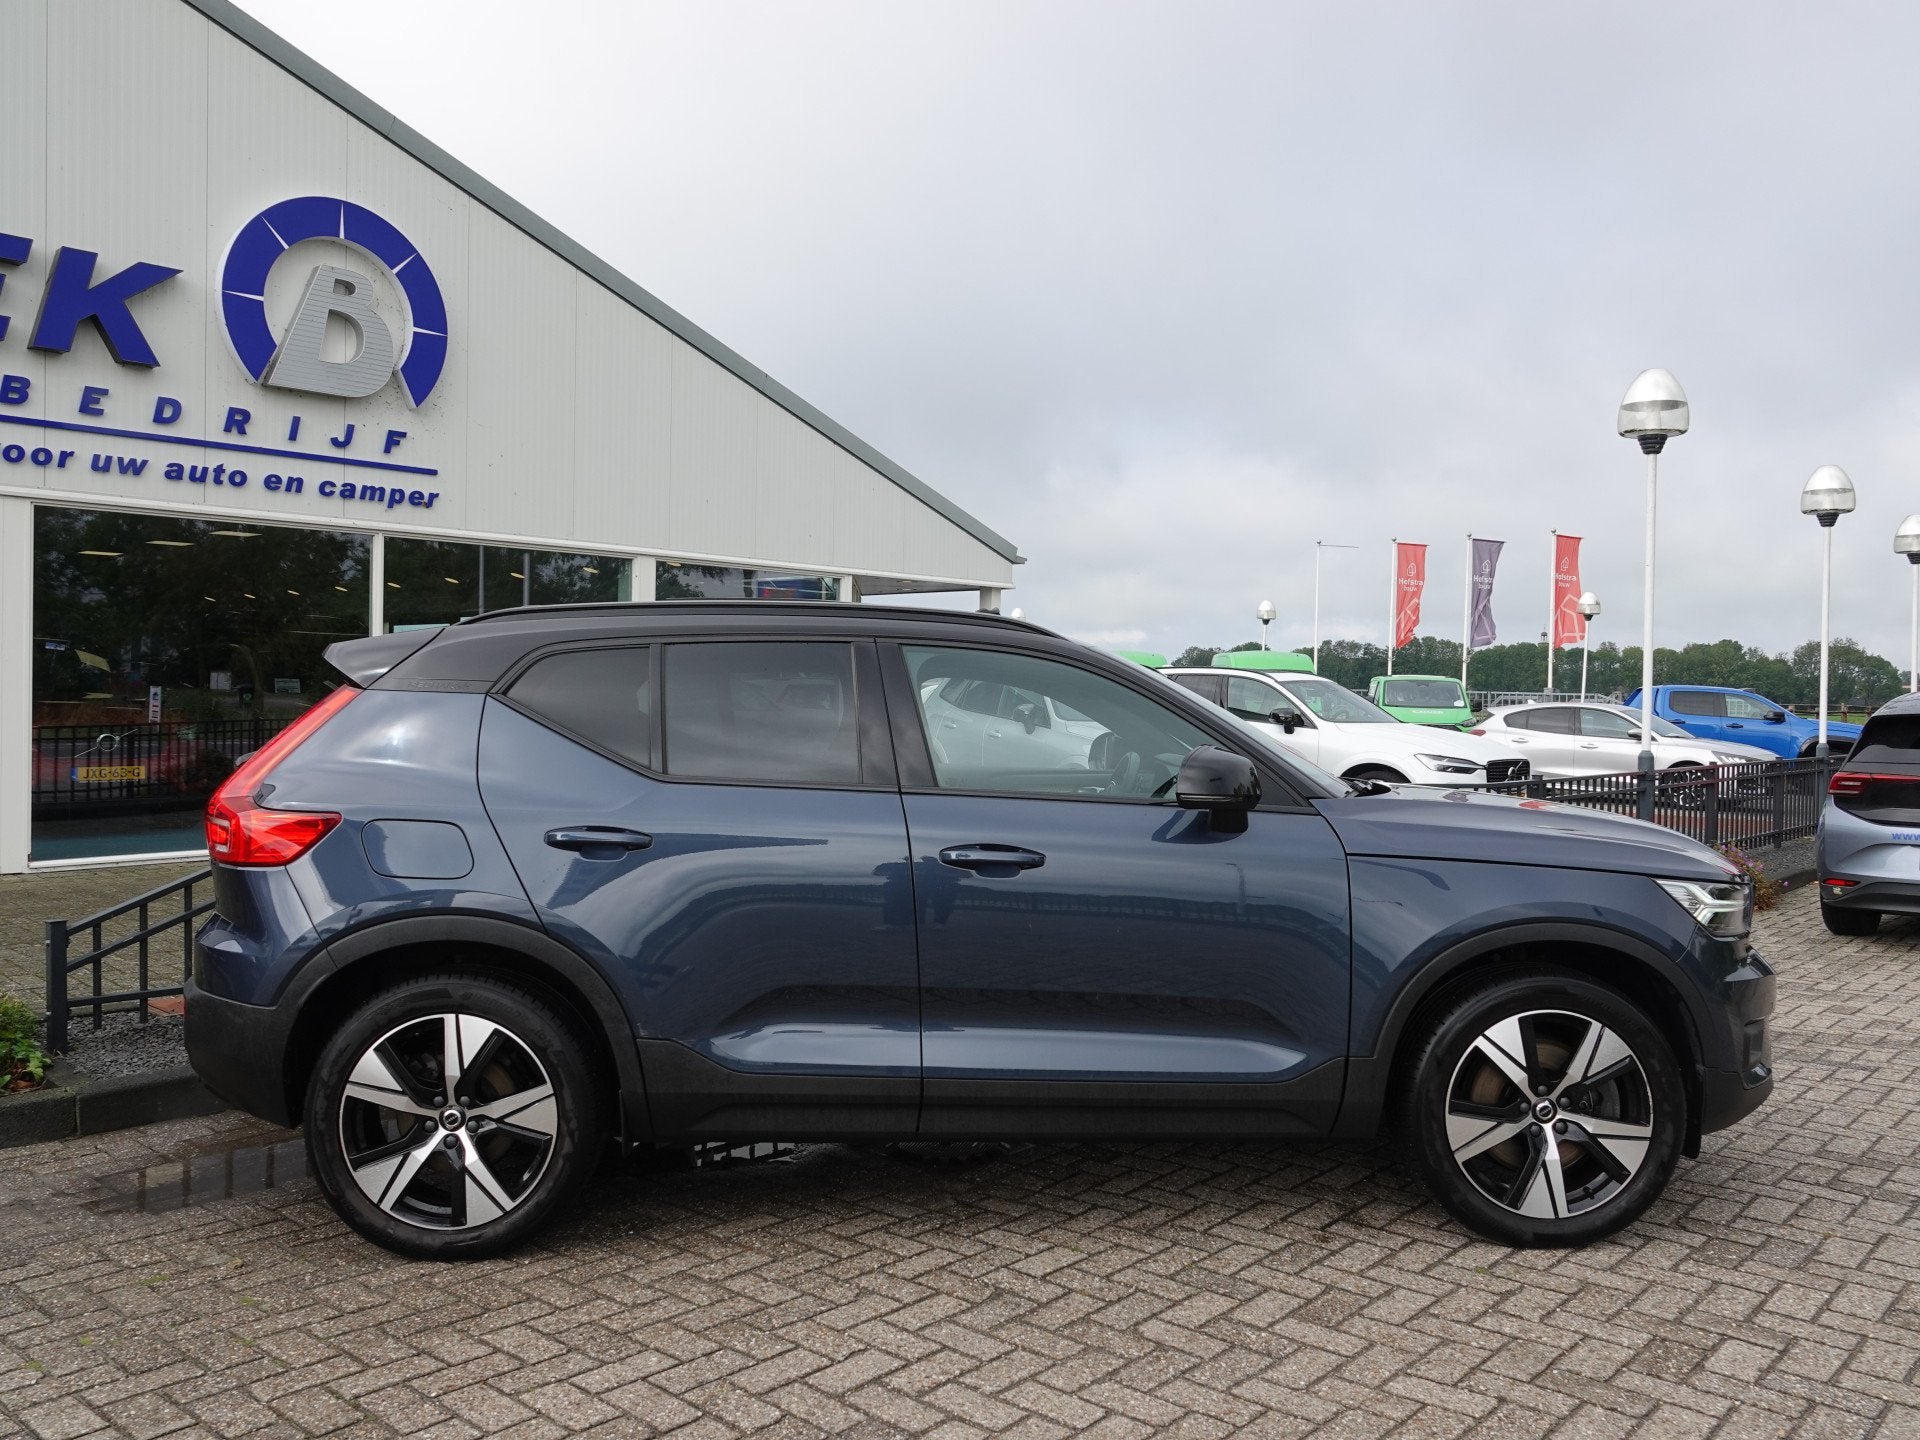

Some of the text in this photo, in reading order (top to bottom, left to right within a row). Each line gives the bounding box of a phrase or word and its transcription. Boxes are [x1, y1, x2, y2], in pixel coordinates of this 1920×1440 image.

[0, 232, 184, 368] K
[1, 374, 407, 454] BEDRIJF
[0, 444, 439, 509] oor uw auto en camper
[82, 766, 142, 780] JXG-63-G
